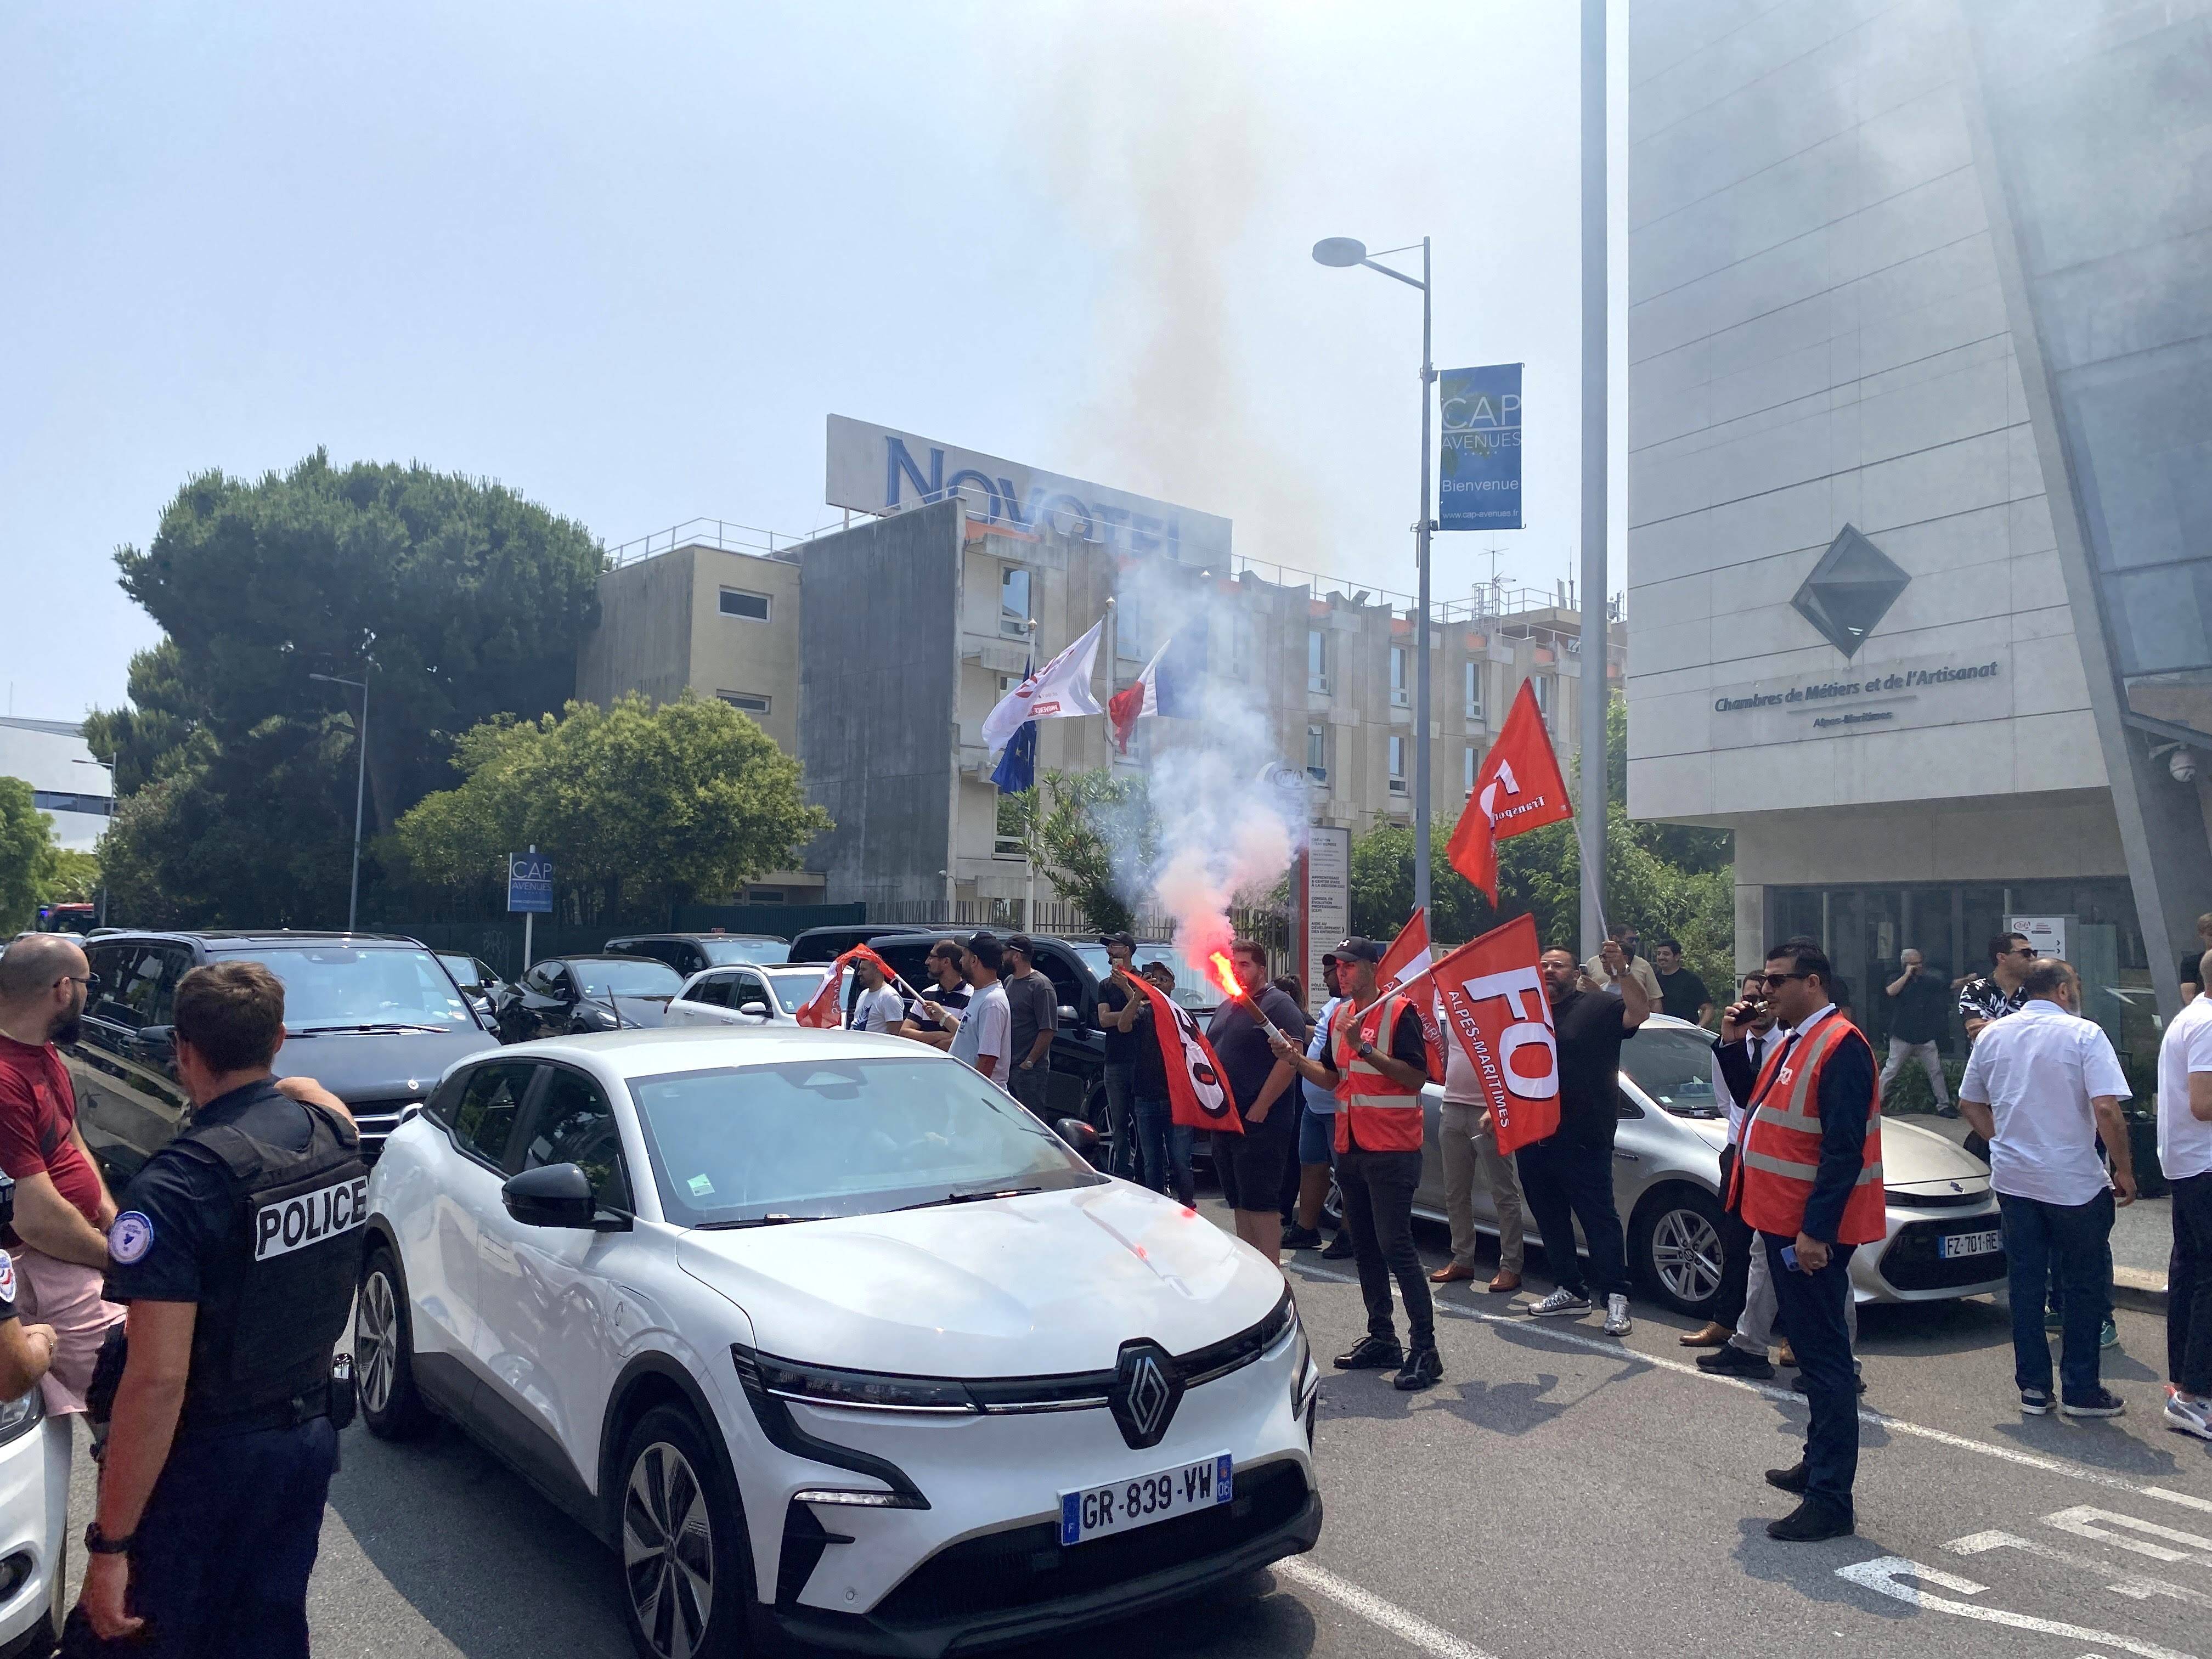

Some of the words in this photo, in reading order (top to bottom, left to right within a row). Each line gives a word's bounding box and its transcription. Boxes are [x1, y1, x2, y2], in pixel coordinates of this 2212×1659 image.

[1442, 394, 1521, 429] CAP
[1442, 432, 1521, 449] AVENUES
[1442, 479, 1519, 492] Bienvenue
[1443, 509, 1519, 519] www.cap-avenues.fr
[1716, 693, 1782, 712] Chambres
[1785, 688, 1803, 703] de
[1805, 682, 1860, 701] Métiers
[1865, 678, 1881, 692] et
[1883, 674, 1904, 689] de
[1906, 662, 1997, 686] l'Artisanat
[512, 861, 552, 879] CAP
[512, 882, 551, 891] AVENUES
[1462, 966, 1559, 1100] FO
[1448, 990, 1509, 1128] ALPES-MARITIMES
[257, 1180, 367, 1256] POLICE
[1082, 1464, 1211, 1530] GR-839-VW
